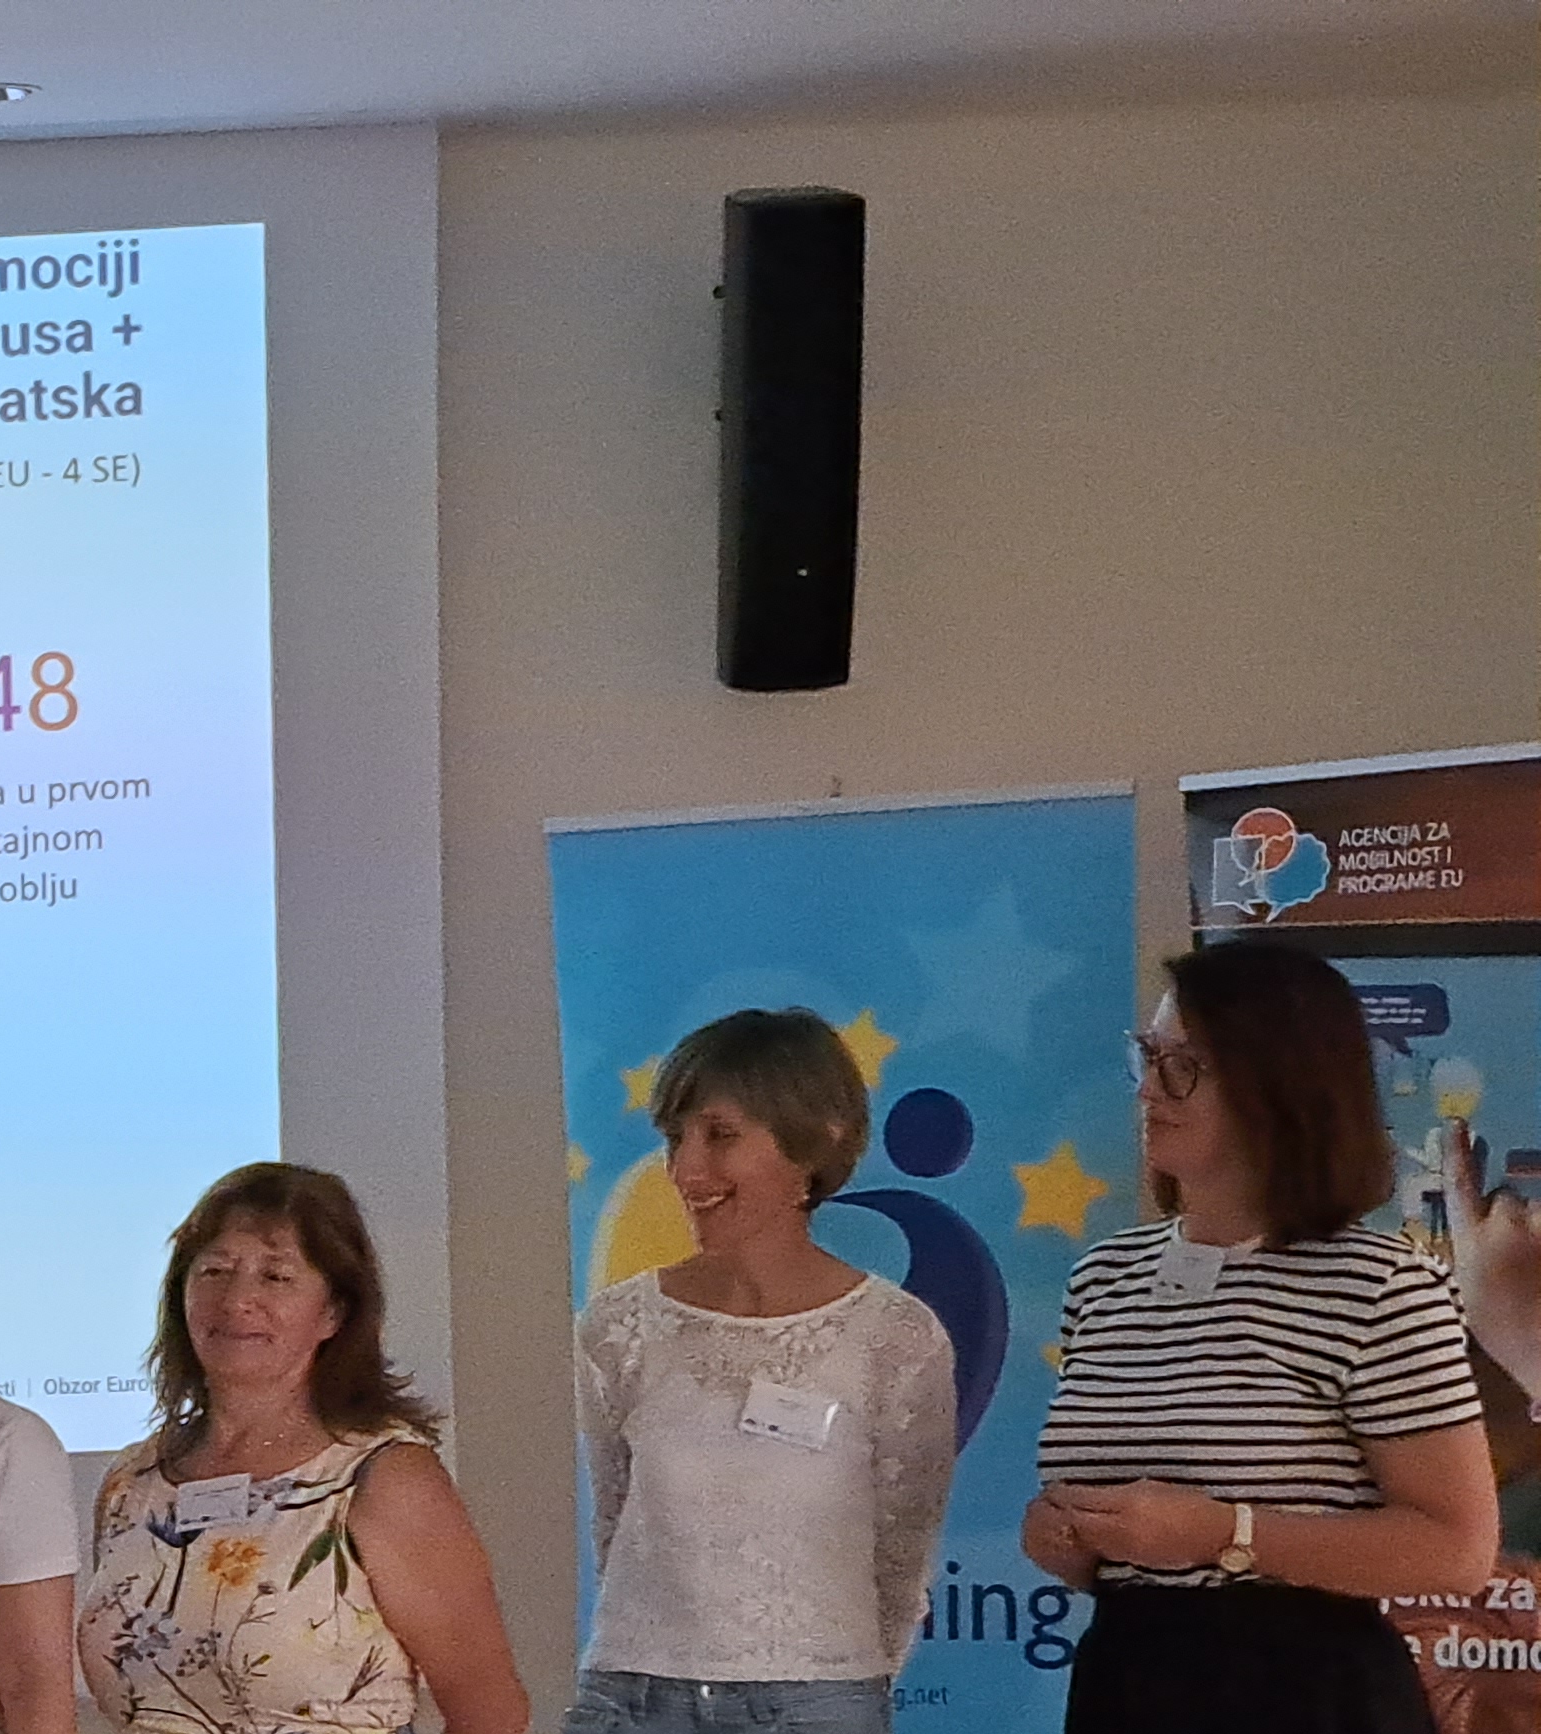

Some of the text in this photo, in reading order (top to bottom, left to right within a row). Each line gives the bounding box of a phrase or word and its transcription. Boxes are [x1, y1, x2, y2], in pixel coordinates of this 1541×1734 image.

[113, 314, 143, 347] +
[63, 458, 83, 485] 4
[93, 453, 142, 488] SE)
[19, 785, 36, 806] u
[49, 778, 151, 810] prvom
[1338, 822, 1452, 847] AGENCIJA ZA
[1446, 845, 1453, 864] I
[1337, 868, 1465, 895] PROGRAME EU
[43, 1377, 102, 1396] Obzor
[106, 1375, 155, 1395] Euro
[1484, 1577, 1537, 1611] za
